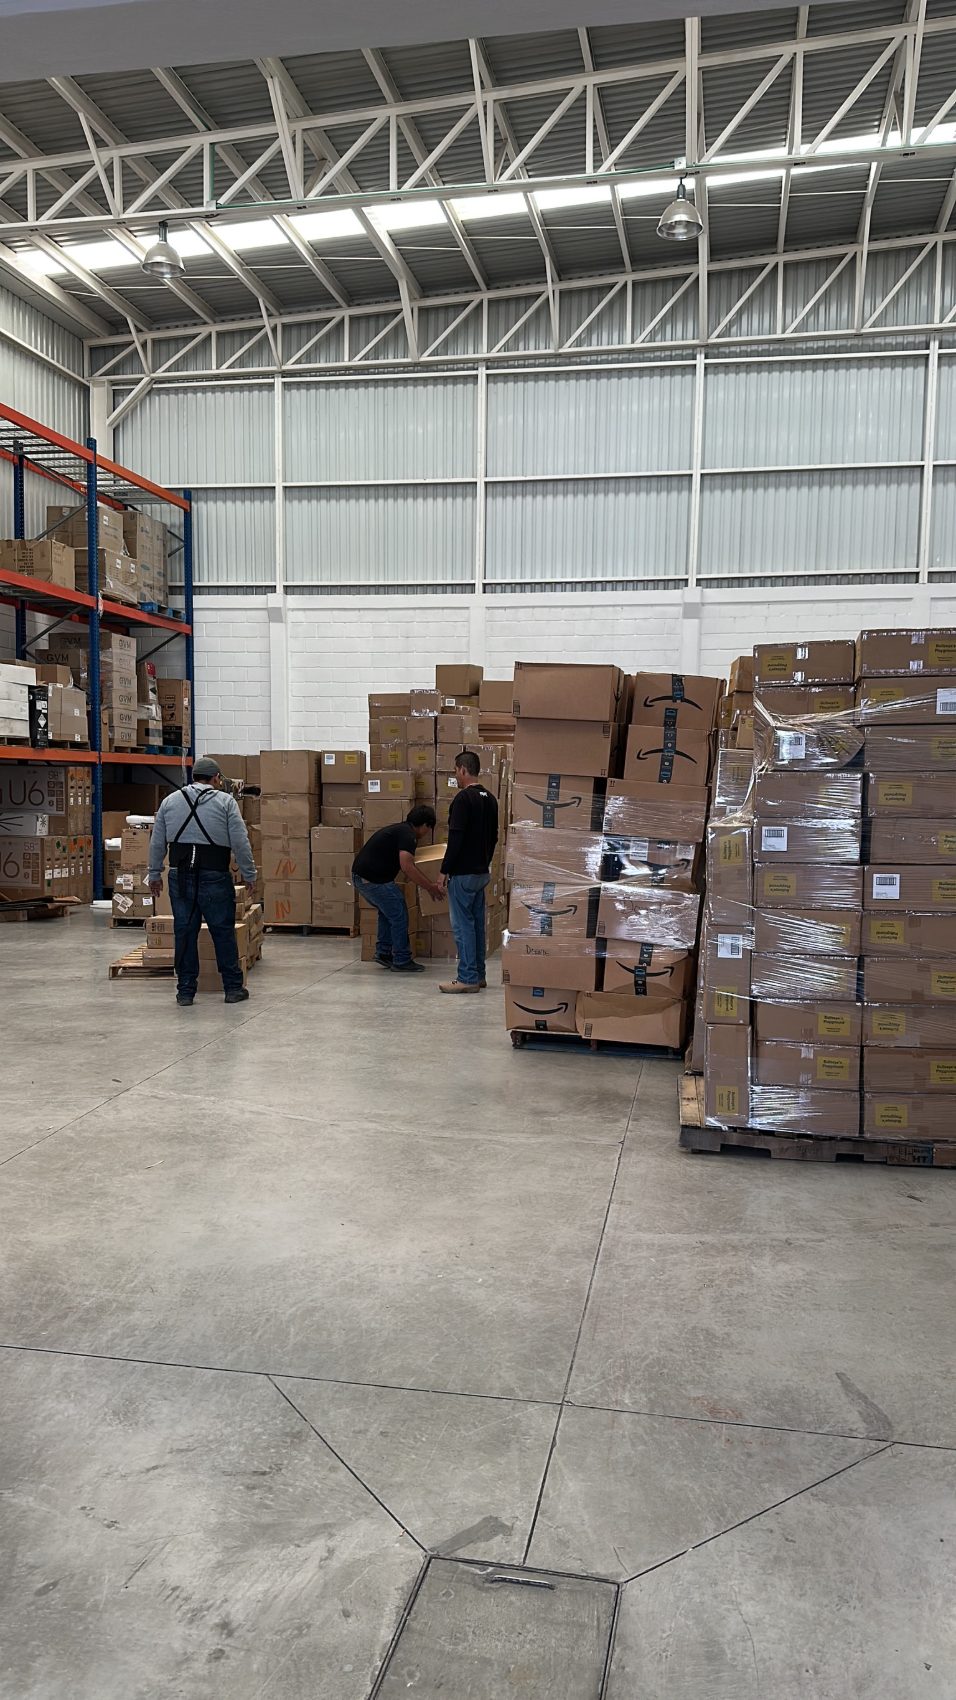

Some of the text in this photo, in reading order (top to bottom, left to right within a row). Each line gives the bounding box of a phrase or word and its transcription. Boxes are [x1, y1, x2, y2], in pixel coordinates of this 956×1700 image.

[119, 639, 131, 649] GVM
[47, 653, 69, 662] GVM
[118, 694, 132, 704] GVM
[119, 713, 132, 723] GVM
[120, 731, 132, 741] GVM
[9, 779, 45, 806] U6
[0, 851, 20, 879] 6
